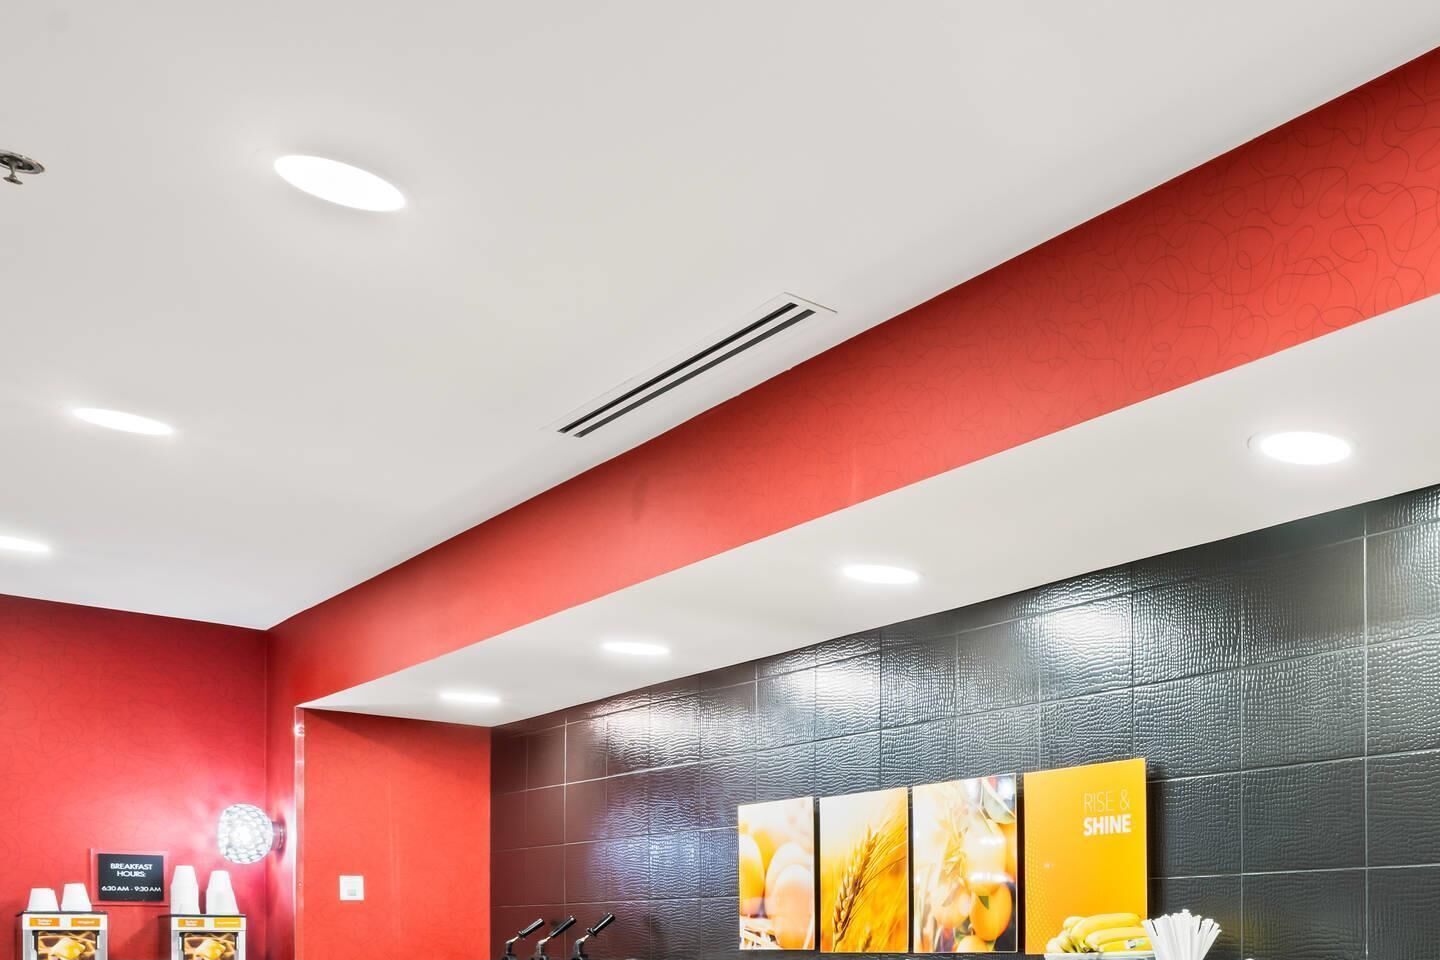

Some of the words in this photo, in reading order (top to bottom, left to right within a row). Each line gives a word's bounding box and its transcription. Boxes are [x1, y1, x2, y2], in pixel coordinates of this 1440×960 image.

[1084, 791, 1115, 813] RISE
[1120, 788, 1130, 810] &
[1083, 813, 1132, 836] SHINE
